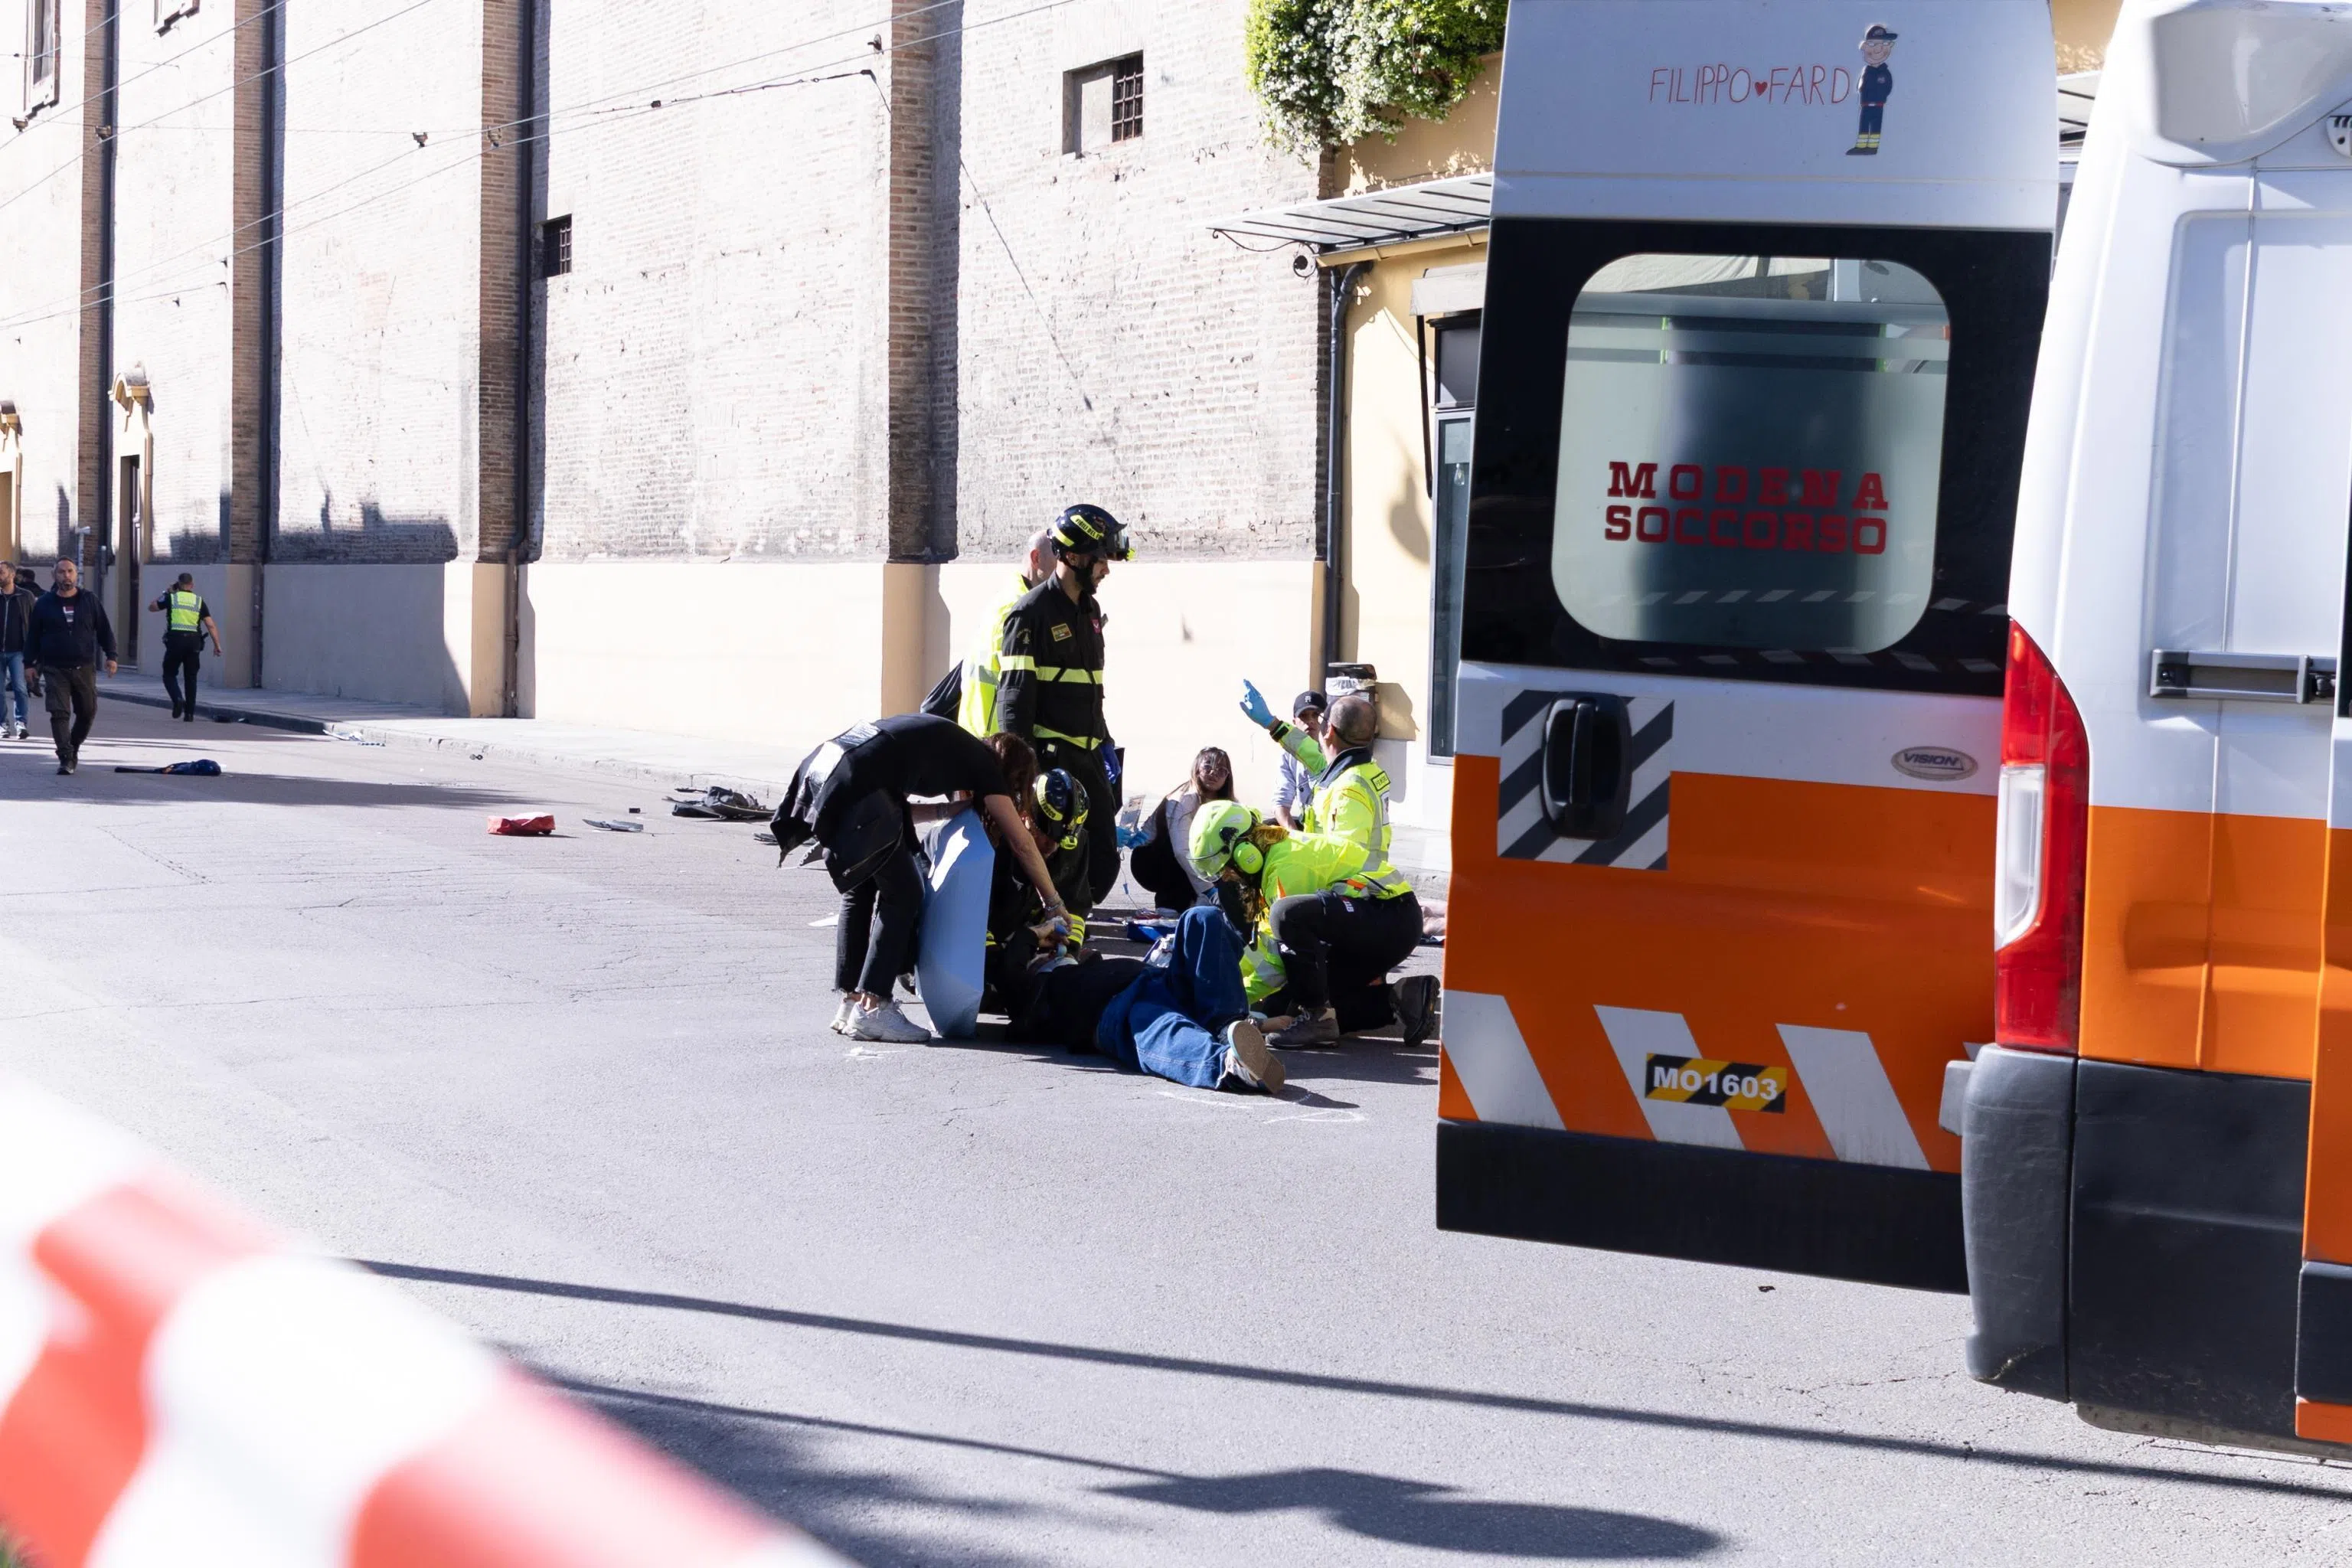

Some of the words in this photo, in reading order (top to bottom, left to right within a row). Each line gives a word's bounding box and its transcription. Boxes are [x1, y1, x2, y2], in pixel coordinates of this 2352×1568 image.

[1649, 64, 1751, 104] FILIPPO
[1768, 65, 1851, 106] FARD
[1608, 461, 1888, 510] MODENA
[1605, 505, 1886, 554] SOCCORSO
[1903, 753, 1959, 766] VISION
[1654, 1067, 1777, 1100] MO1603
